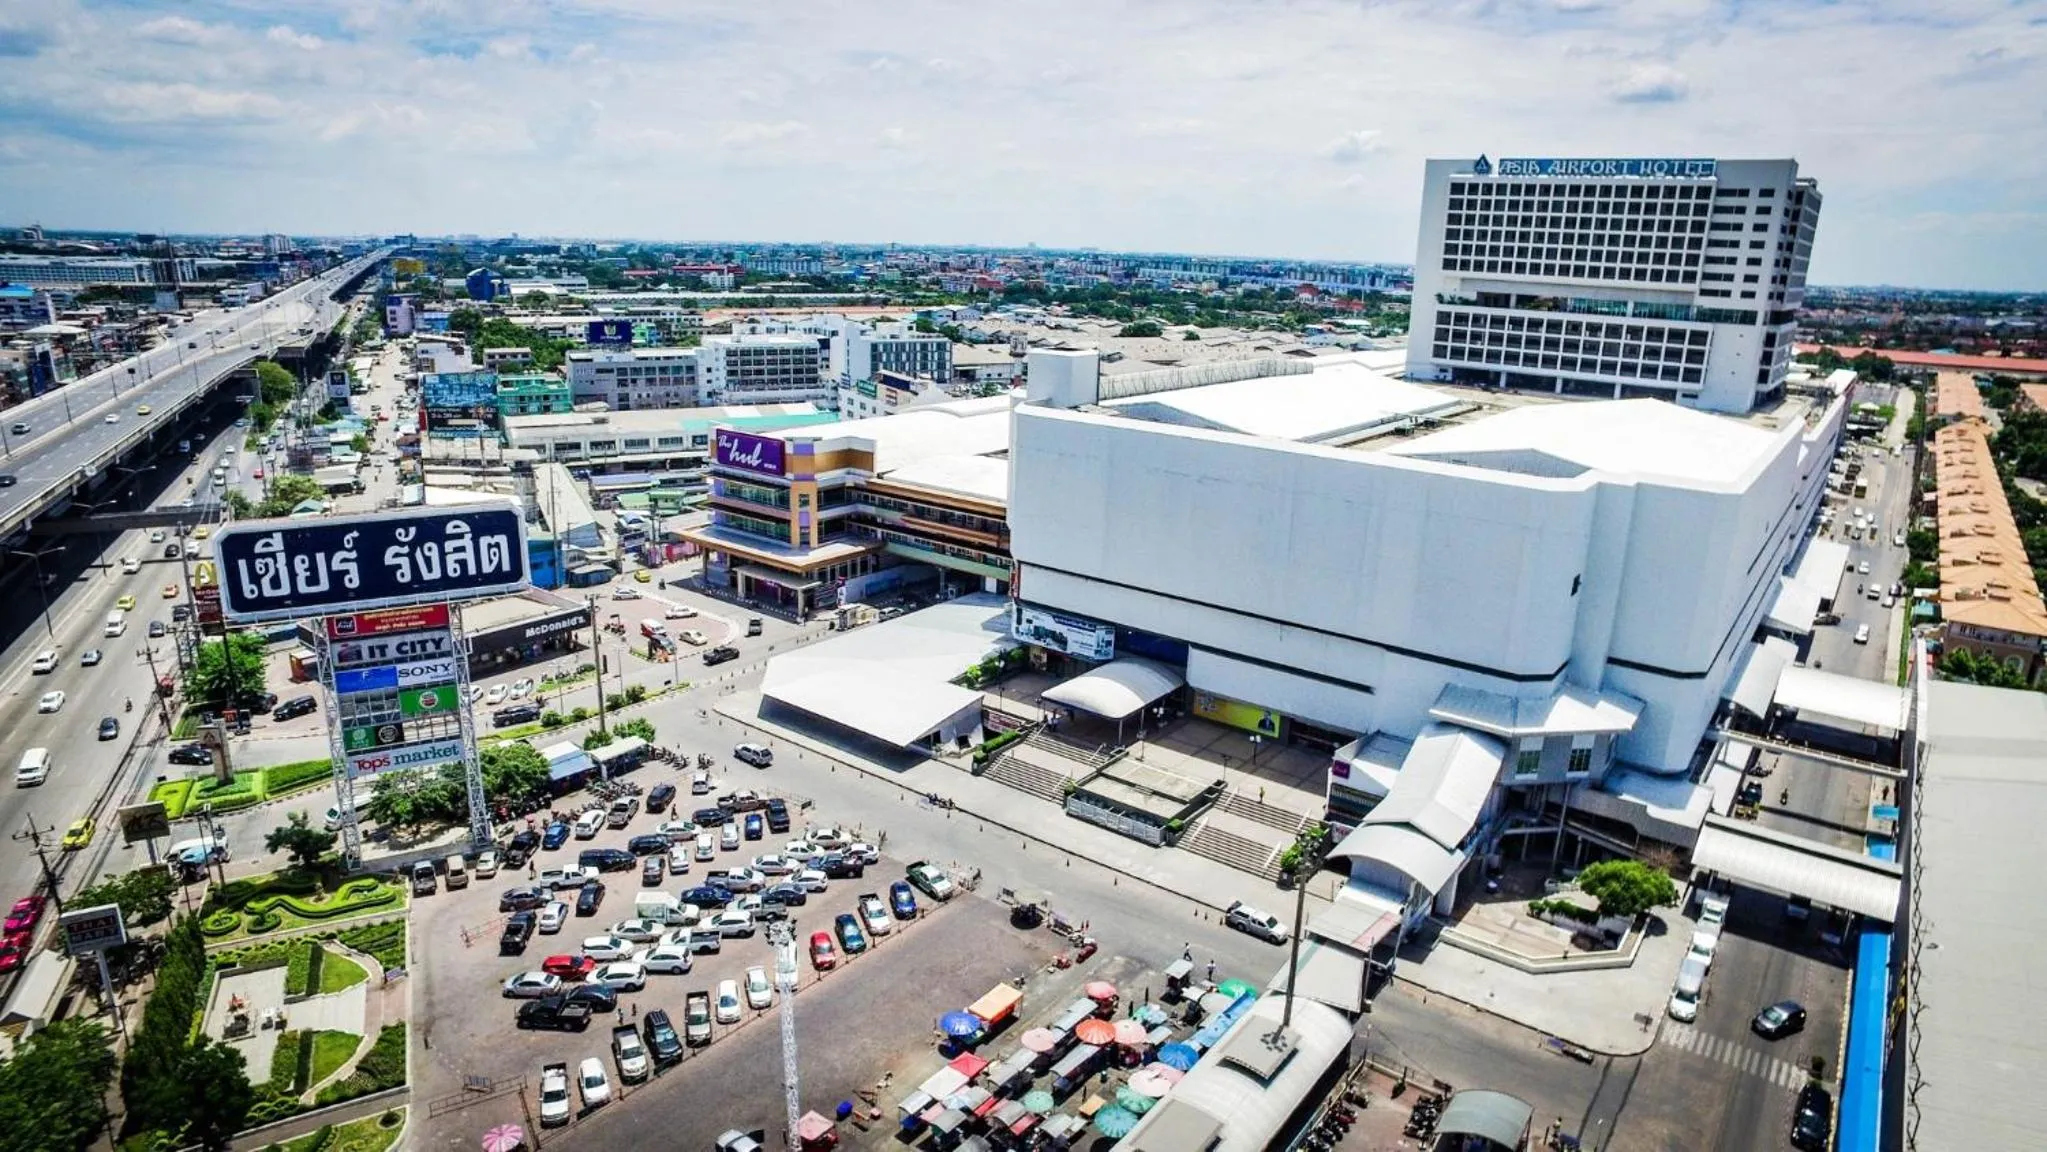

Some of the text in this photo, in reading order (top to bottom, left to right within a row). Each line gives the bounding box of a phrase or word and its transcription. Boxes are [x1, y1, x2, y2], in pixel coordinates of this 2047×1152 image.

[1500, 160, 1714, 176] ASIA AIRPORT HOTEL
[729, 438, 762, 467] hub
[238, 520, 511, 599] เซียร์ รังสิต
[526, 617, 584, 638] McDonald's
[367, 637, 445, 658] IT CITY
[399, 663, 452, 677] SONY
[355, 744, 460, 772] Tops market
